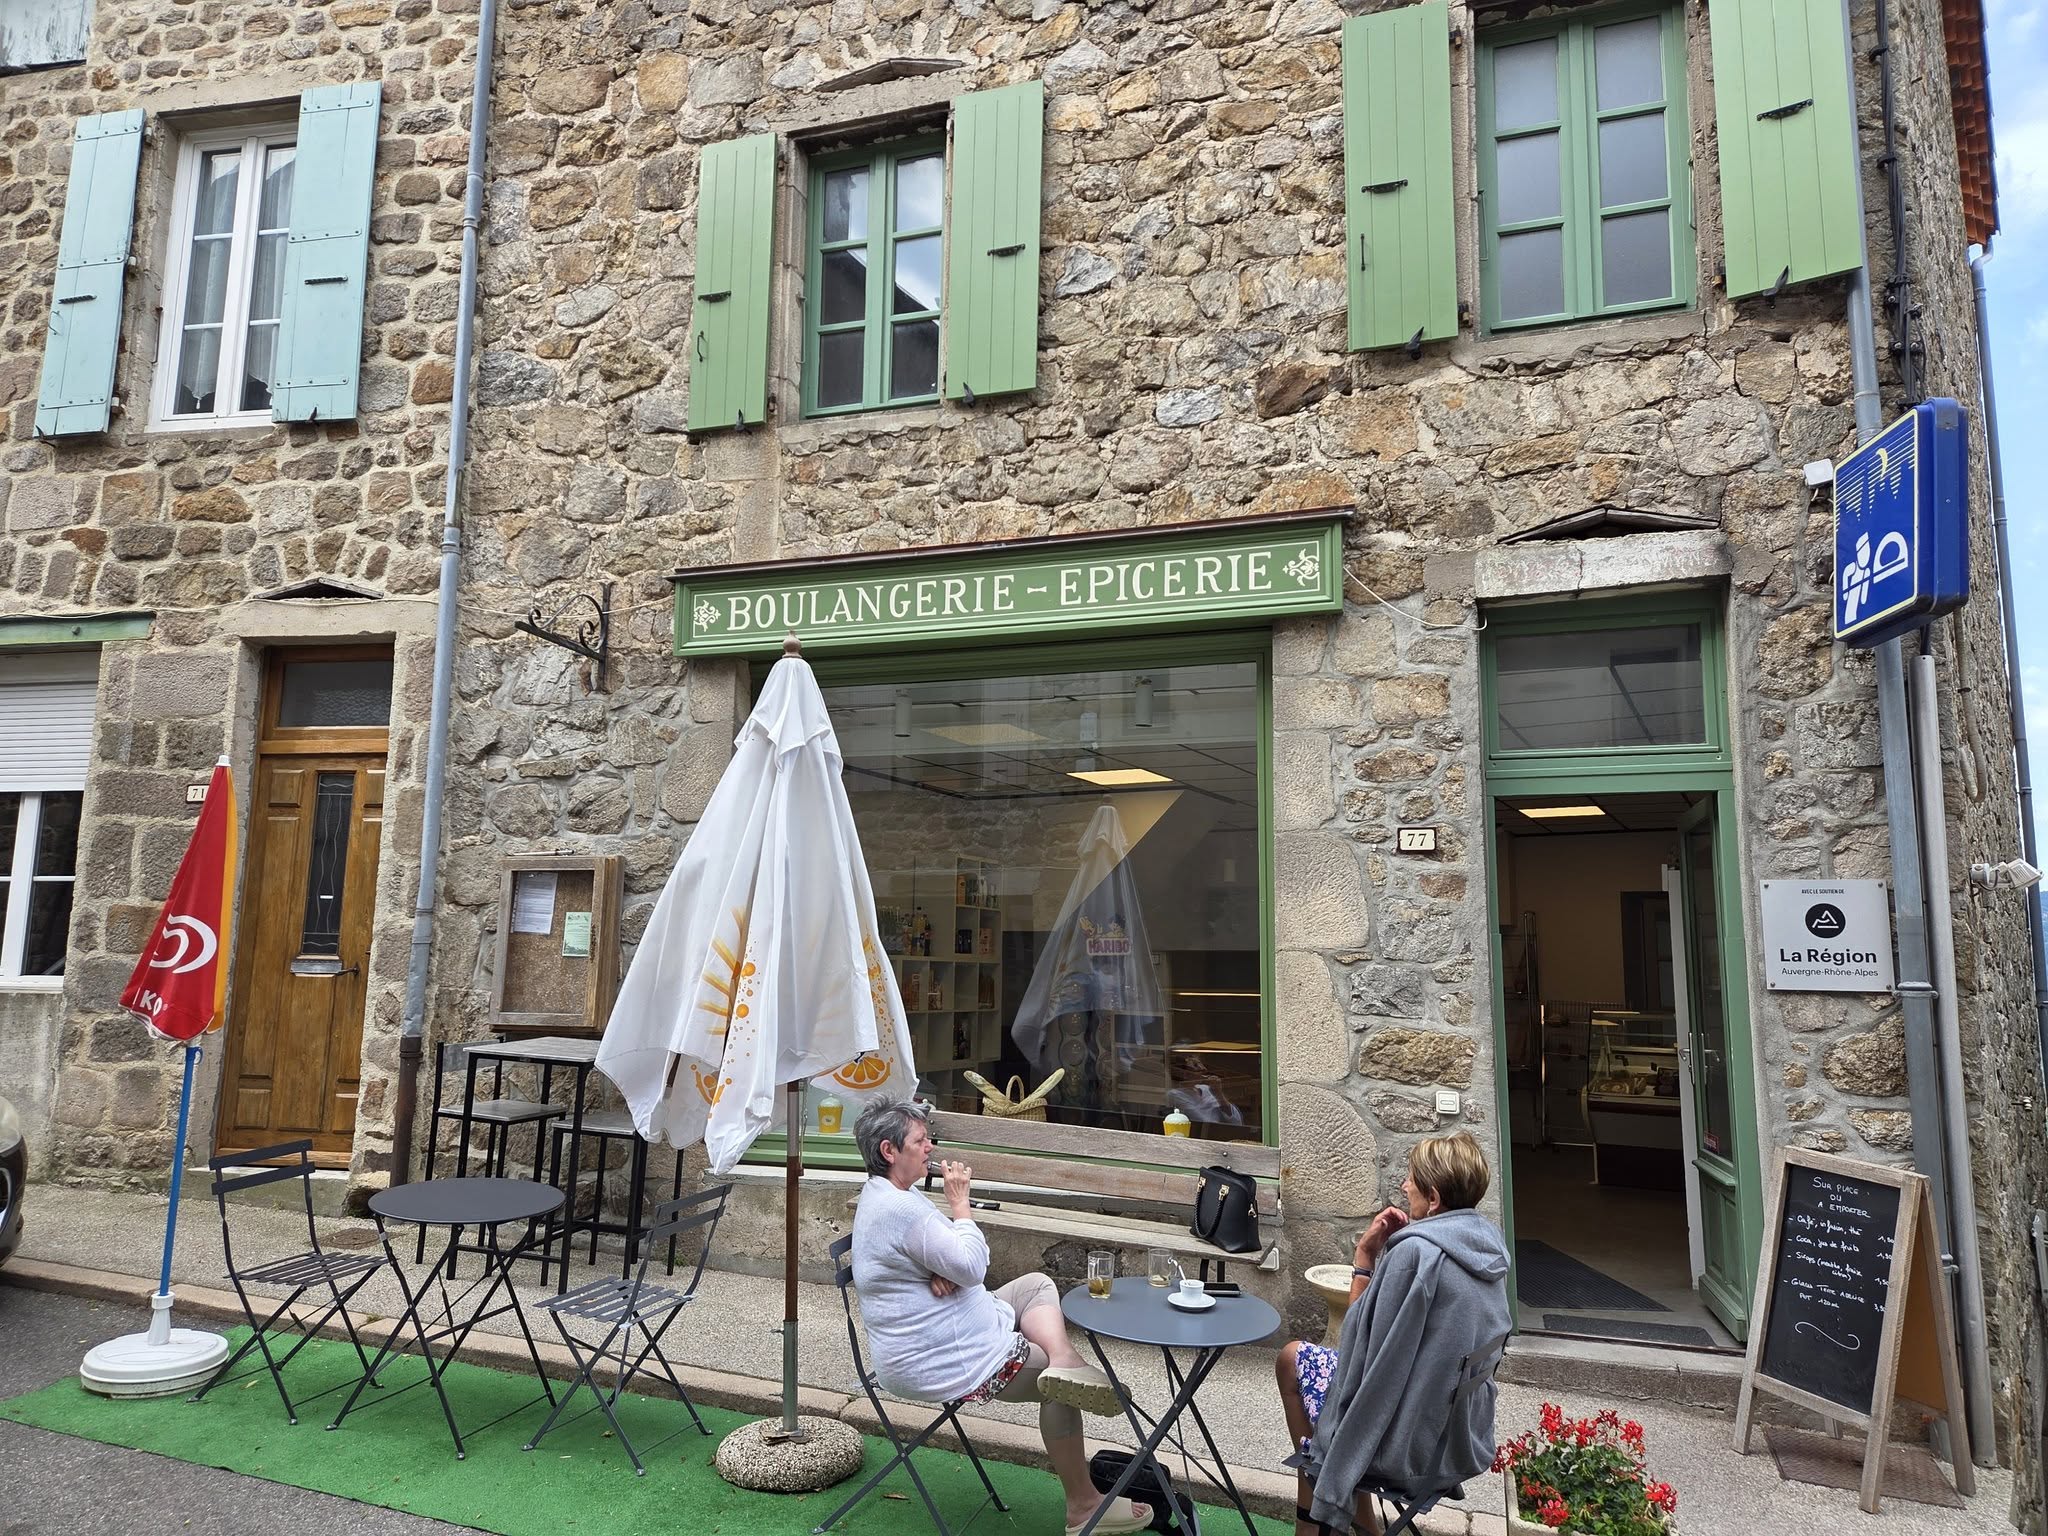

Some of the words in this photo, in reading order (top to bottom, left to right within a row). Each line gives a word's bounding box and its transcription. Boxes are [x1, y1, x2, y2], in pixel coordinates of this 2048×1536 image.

[726, 574, 1017, 632] BOULANGERIE
[1060, 550, 1273, 606] EPICERIE
[192, 788, 205, 799] 71
[1407, 833, 1427, 847] 77
[1088, 939, 1130, 954] HARIBO
[1779, 948, 1802, 963] La
[1807, 948, 1877, 966] Région
[1781, 967, 1879, 978] Auvergne-Rhône-Alpes
